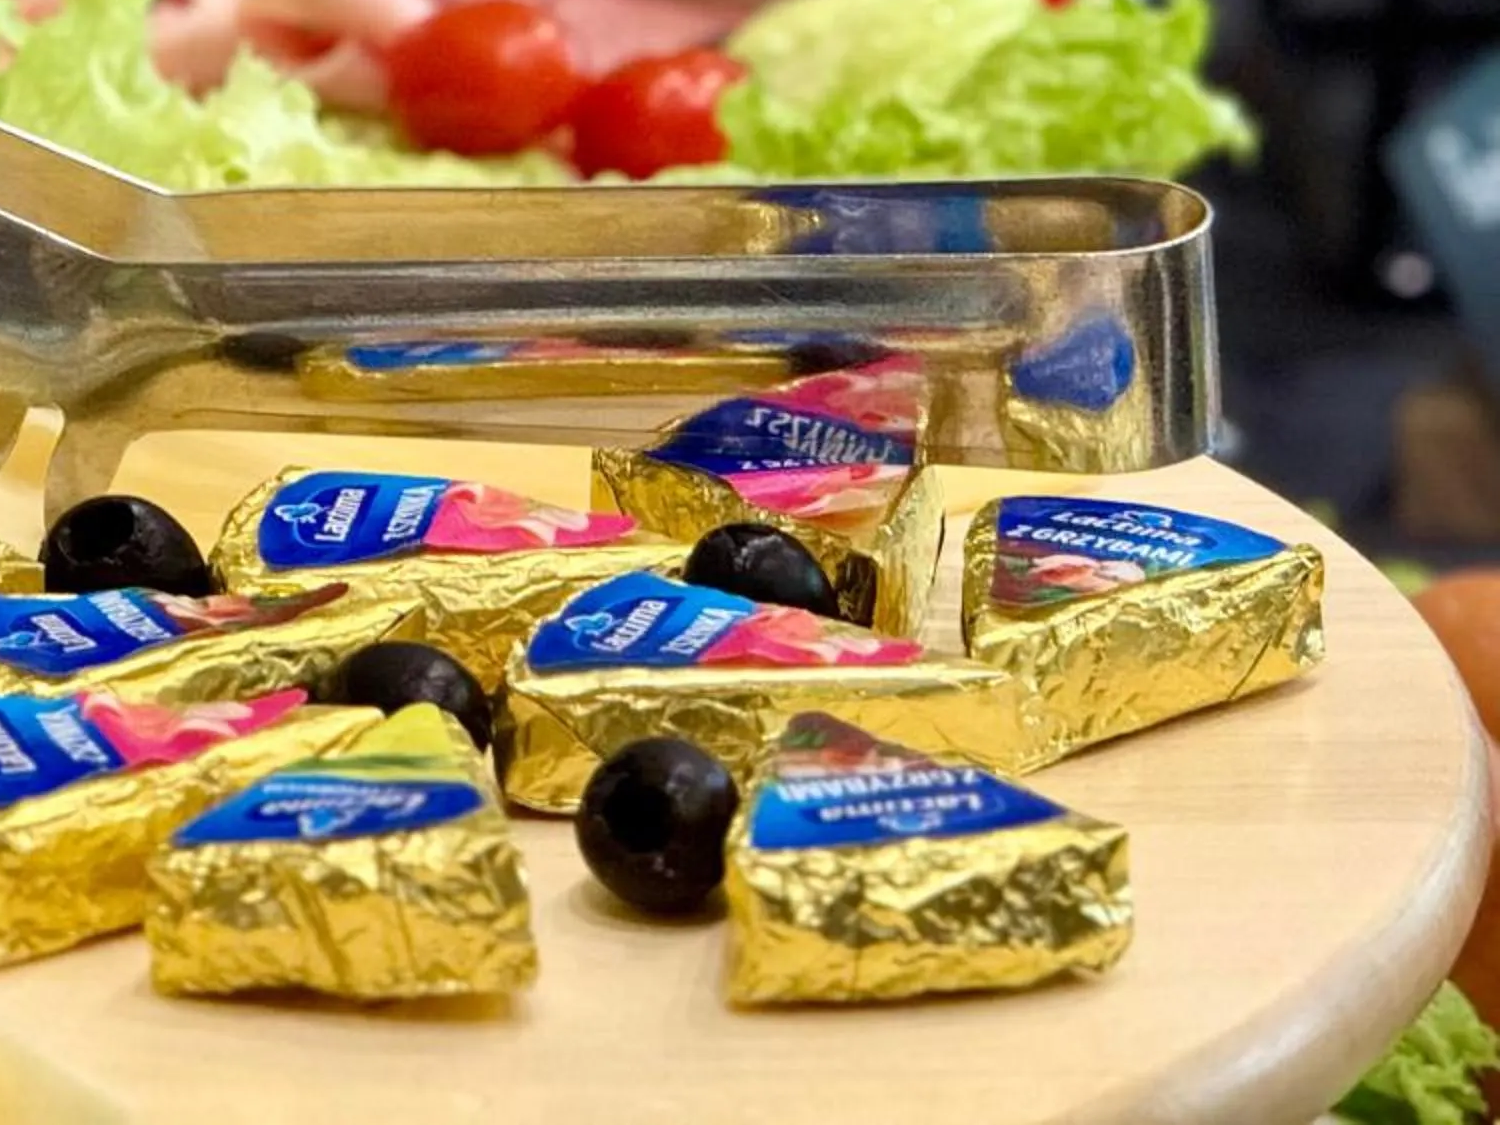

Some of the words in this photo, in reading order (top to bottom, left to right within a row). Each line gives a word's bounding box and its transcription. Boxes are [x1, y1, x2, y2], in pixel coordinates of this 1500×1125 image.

[314, 488, 366, 543] Lactima
[1051, 511, 1201, 546] Lactima
[1006, 524, 1033, 538] Z
[1031, 528, 1197, 566] GRZYBAMI
